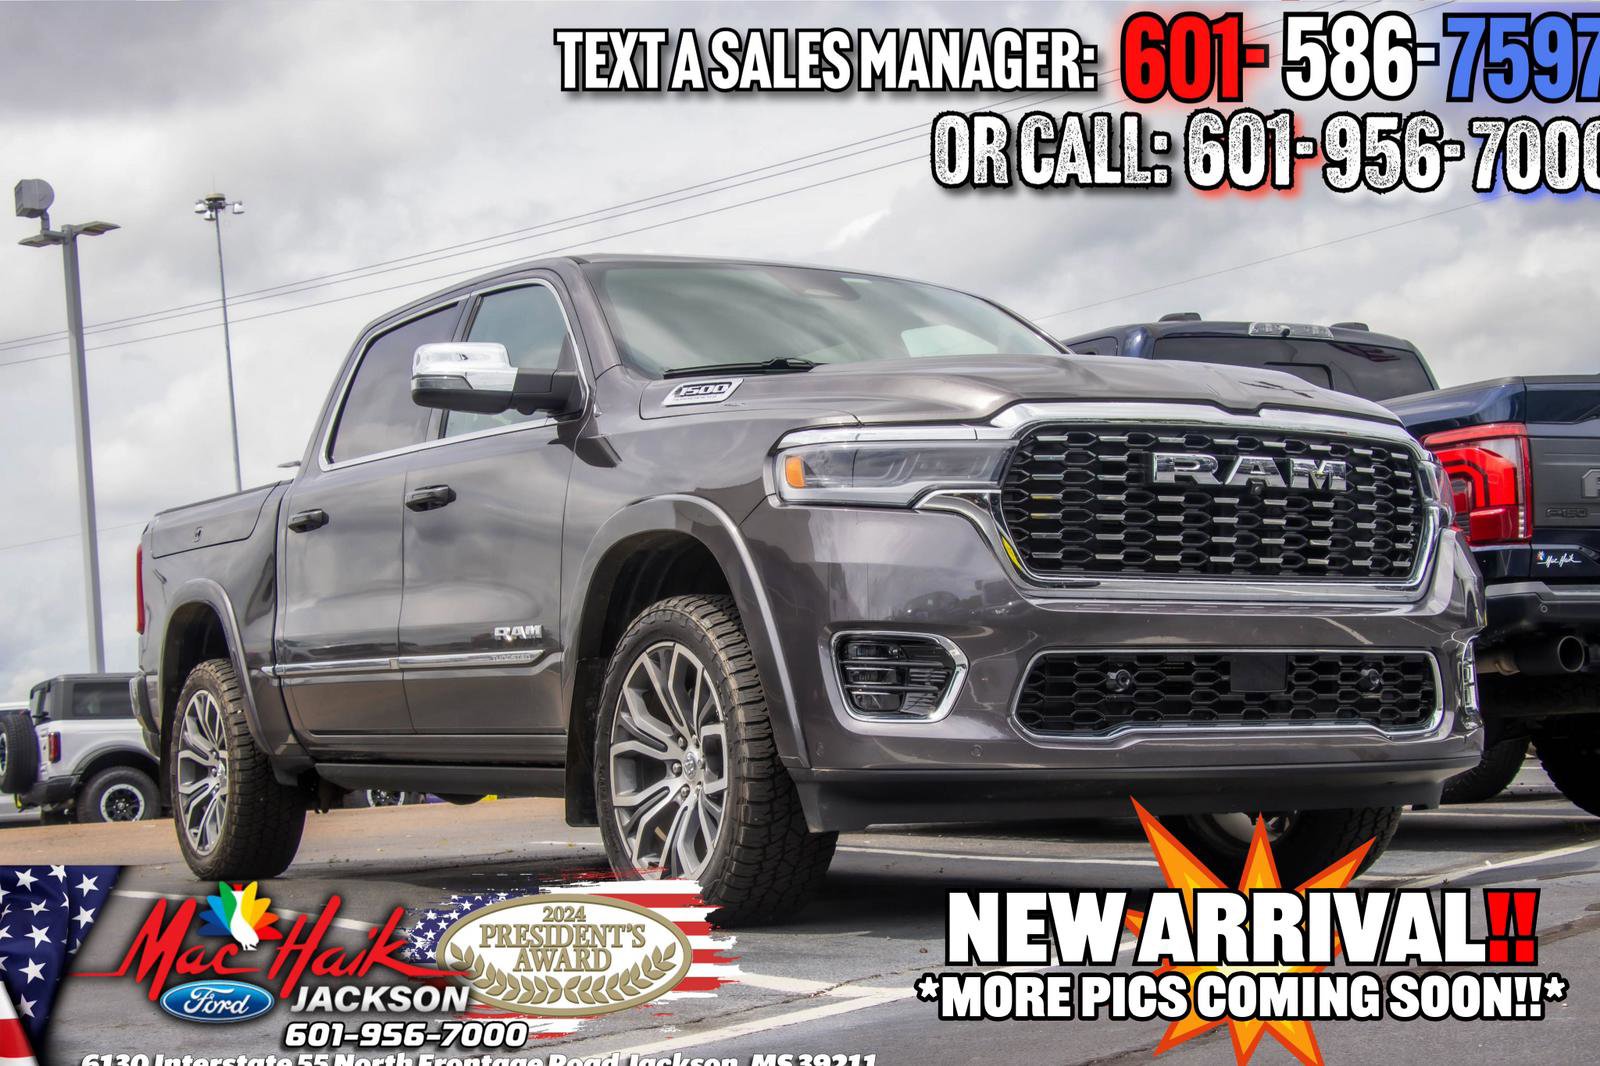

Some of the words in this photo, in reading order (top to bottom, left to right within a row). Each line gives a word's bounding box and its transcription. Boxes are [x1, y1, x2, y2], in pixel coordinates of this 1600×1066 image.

[679, 383, 731, 397] 1500
[1152, 452, 1347, 491] RAM
[494, 624, 542, 641] RAM
